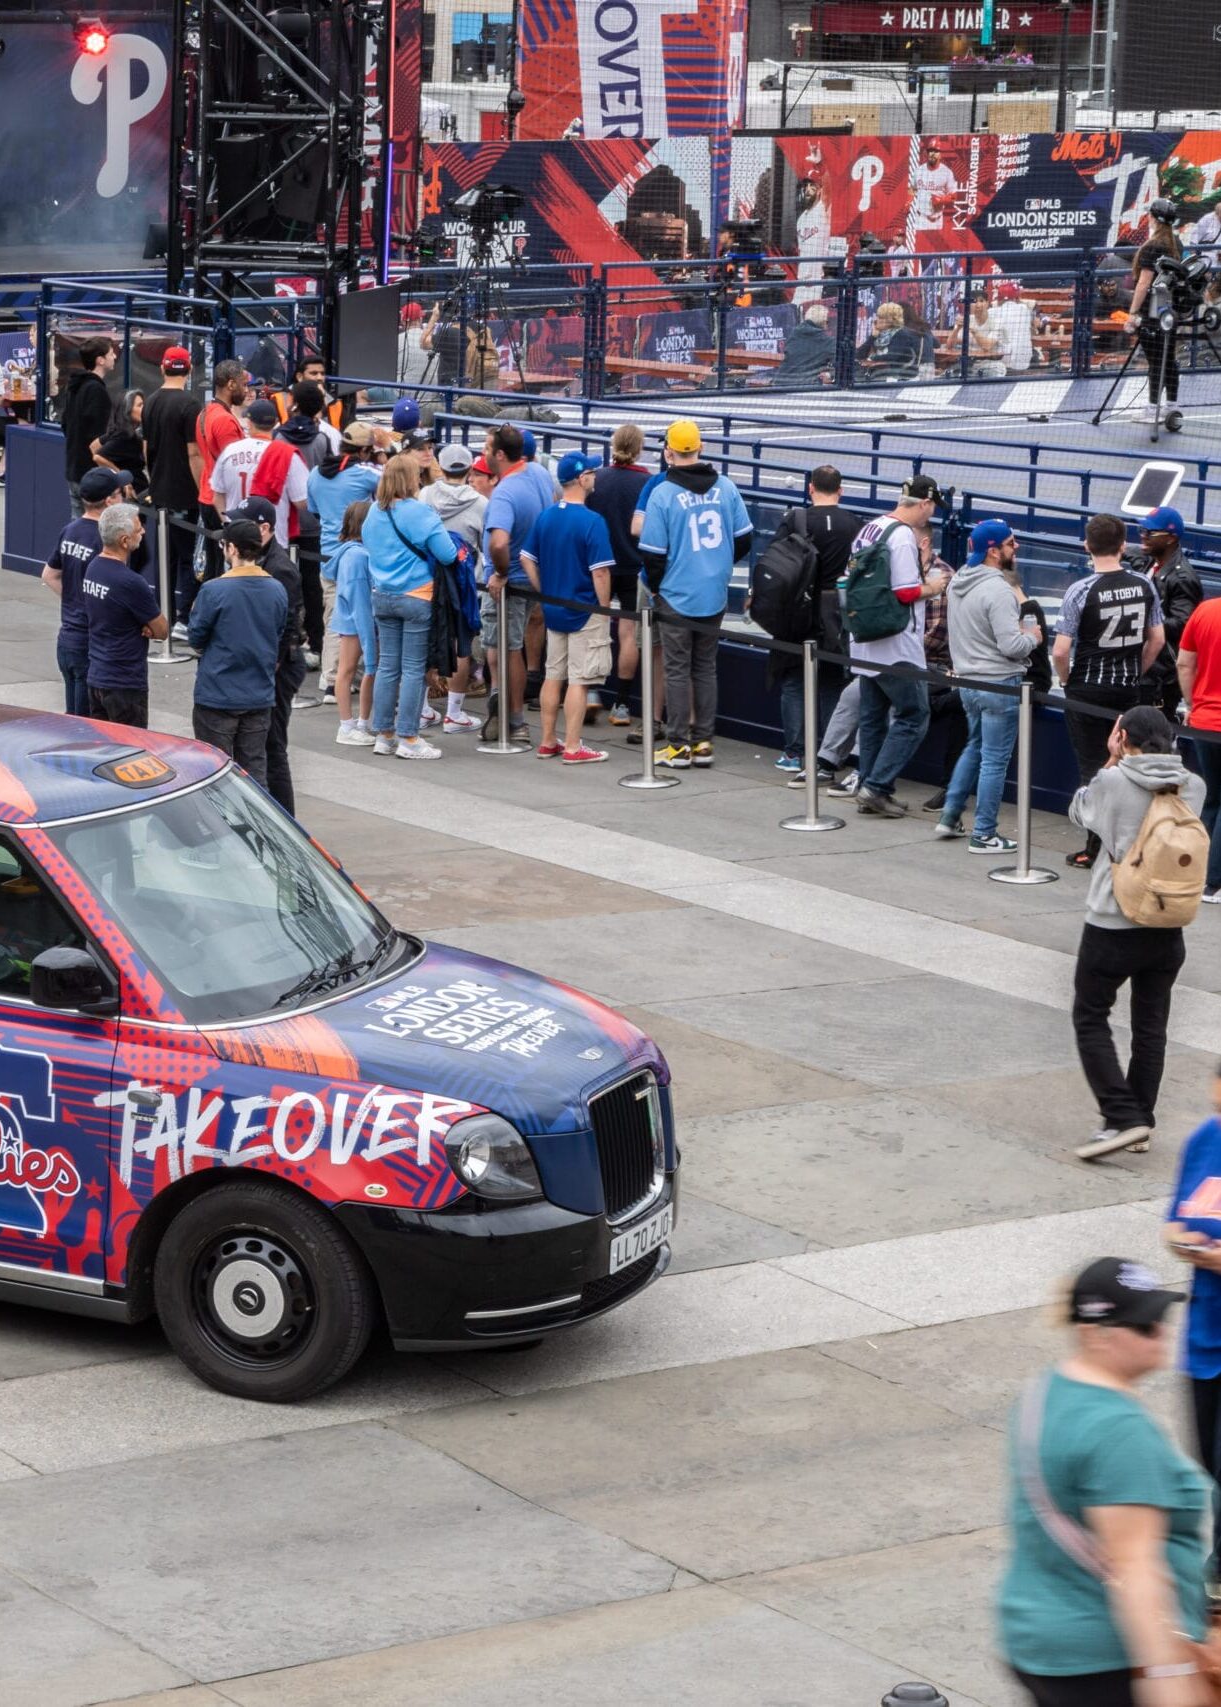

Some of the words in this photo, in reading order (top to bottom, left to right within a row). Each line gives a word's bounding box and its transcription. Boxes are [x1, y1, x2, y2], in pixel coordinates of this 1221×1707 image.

[903, 8, 936, 29] PRET
[939, 8, 950, 29] A
[70, 33, 168, 198] P
[851, 154, 885, 212] P
[967, 137, 980, 215] SCHWARBER
[951, 180, 970, 231] KYLE
[987, 212, 1048, 228] LONDON
[1049, 210, 1097, 226] SERIES
[1041, 199, 1061, 209] MLB
[1008, 229, 1047, 238] TRAFALGAR
[1048, 228, 1075, 237] SQUARE
[655, 334, 696, 351] LONDON
[736, 328, 763, 340] WORLD
[688, 510, 723, 552] 13
[60, 540, 94, 561] STAFF
[82, 579, 110, 600] STAFF
[1098, 590, 1113, 602] MR
[1098, 602, 1146, 648] 23
[118, 756, 167, 780] TAXI
[364, 979, 498, 1038] LONDON
[397, 985, 428, 1002] MLB
[422, 996, 534, 1045] SERIES
[499, 1018, 567, 1058] TAKEOVER
[93, 1080, 471, 1190] TAKEOVER
[616, 1226, 648, 1267] LL70
[649, 1211, 669, 1248] ZJO
